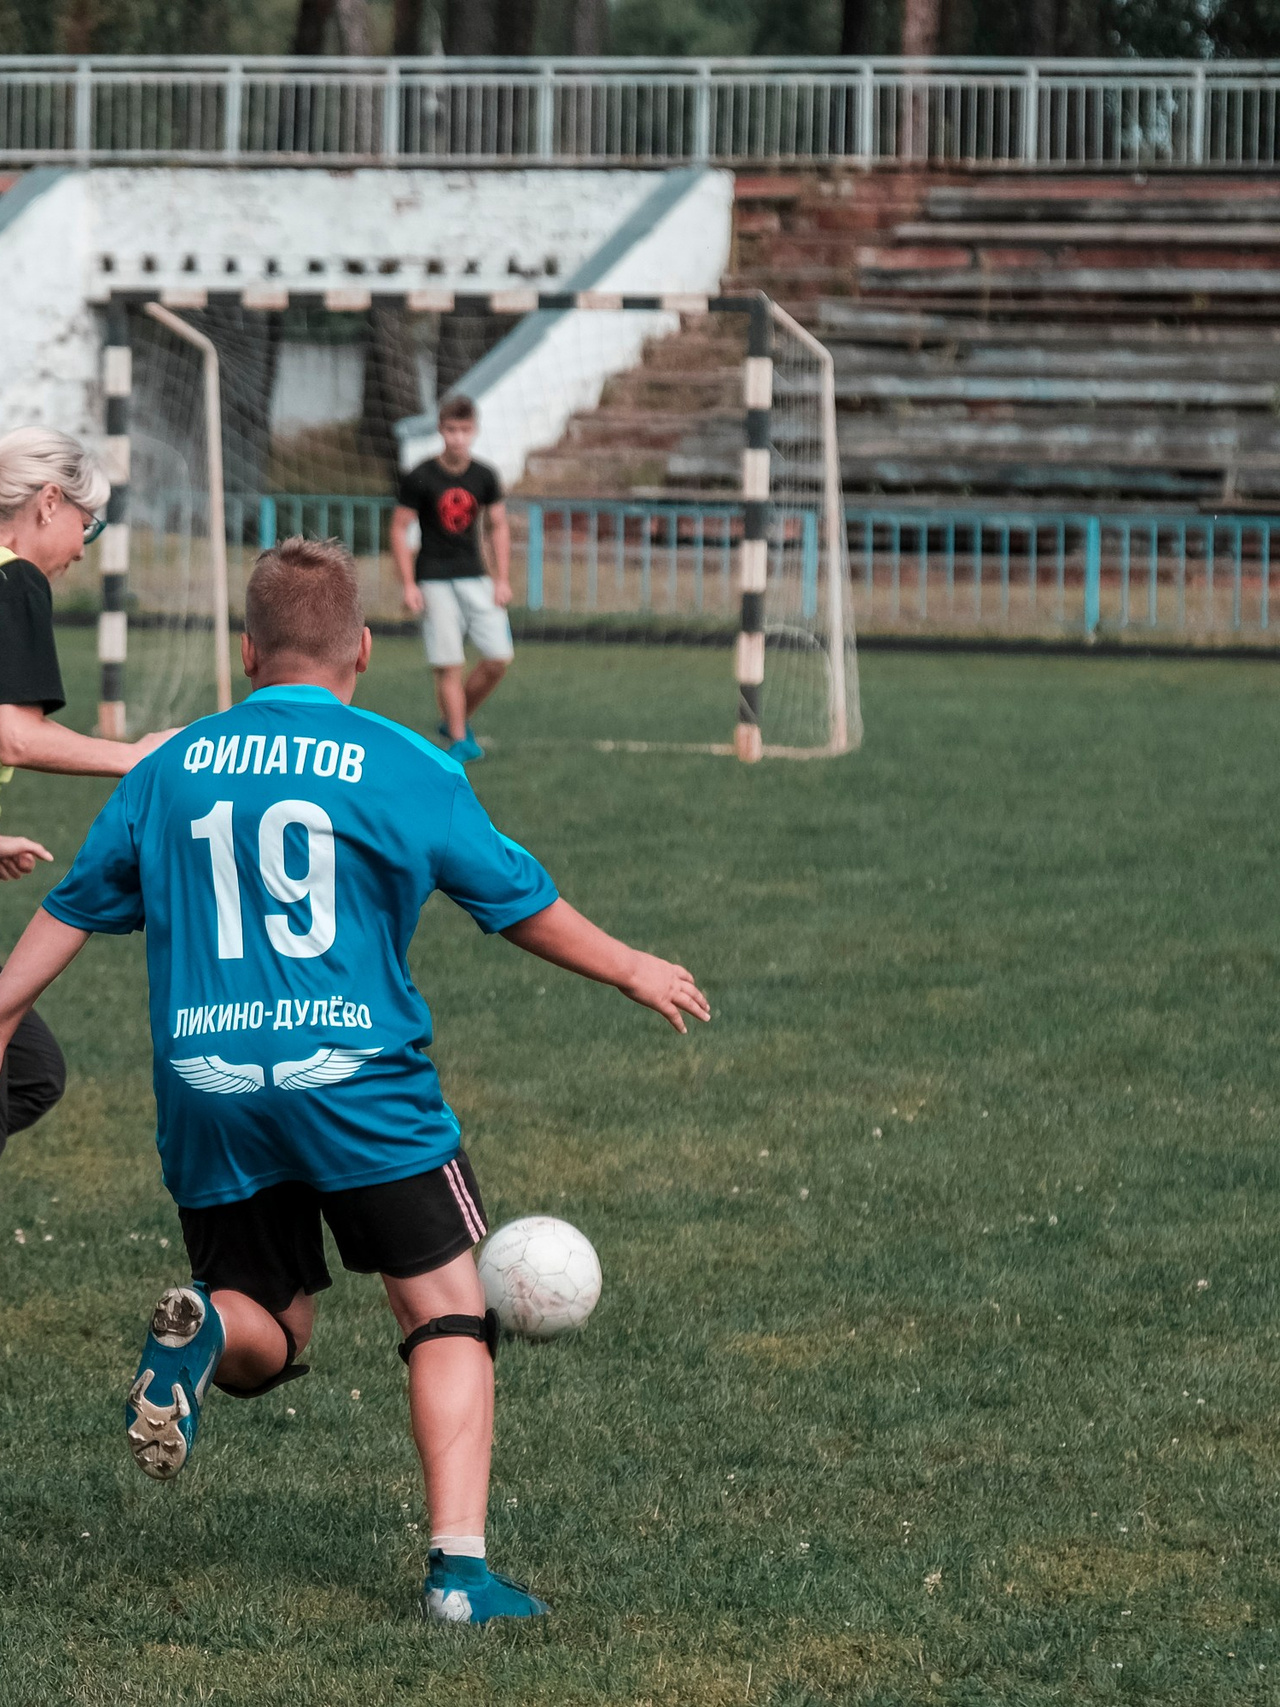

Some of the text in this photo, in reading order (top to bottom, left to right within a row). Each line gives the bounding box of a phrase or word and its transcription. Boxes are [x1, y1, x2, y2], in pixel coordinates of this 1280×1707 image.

[183, 735, 366, 783] ФИЛАТОВ
[190, 799, 337, 959] 19
[173, 996, 373, 1039] ЛИКИНО-ДУЛЁВО
